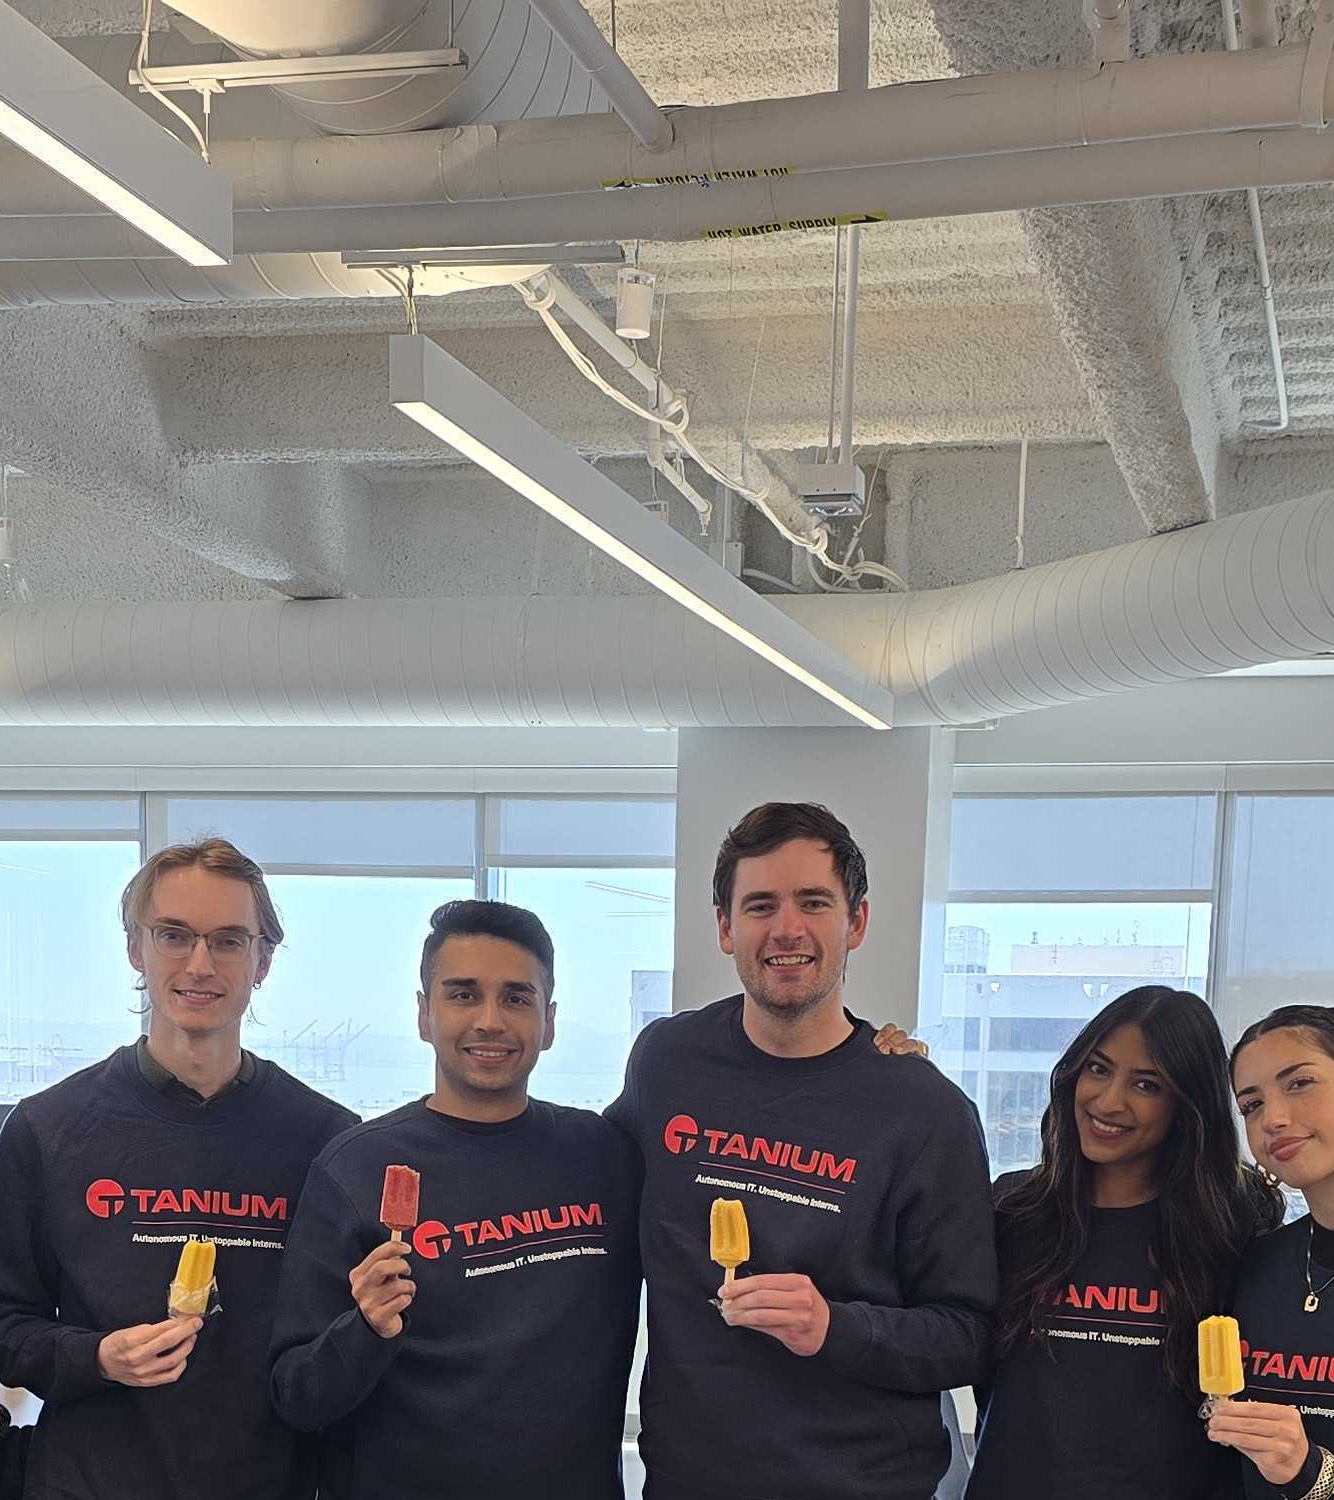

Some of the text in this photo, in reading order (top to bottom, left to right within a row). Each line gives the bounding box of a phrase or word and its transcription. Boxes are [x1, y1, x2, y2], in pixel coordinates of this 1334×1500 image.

[703, 1128, 858, 1184] TANIUM
[130, 1188, 288, 1221] TANIUM
[695, 1173, 748, 1192] Autonomous
[758, 1184, 811, 1207] Unstoppable
[454, 1202, 604, 1248] TANIUM
[132, 1233, 188, 1244] Autonomous
[252, 1238, 285, 1250] Interns.
[465, 1260, 516, 1279] Autonomous
[527, 1247, 581, 1265] Unstoppable
[1050, 1284, 1166, 1314] ANIU
[1101, 1332, 1161, 1346] Unstoppable
